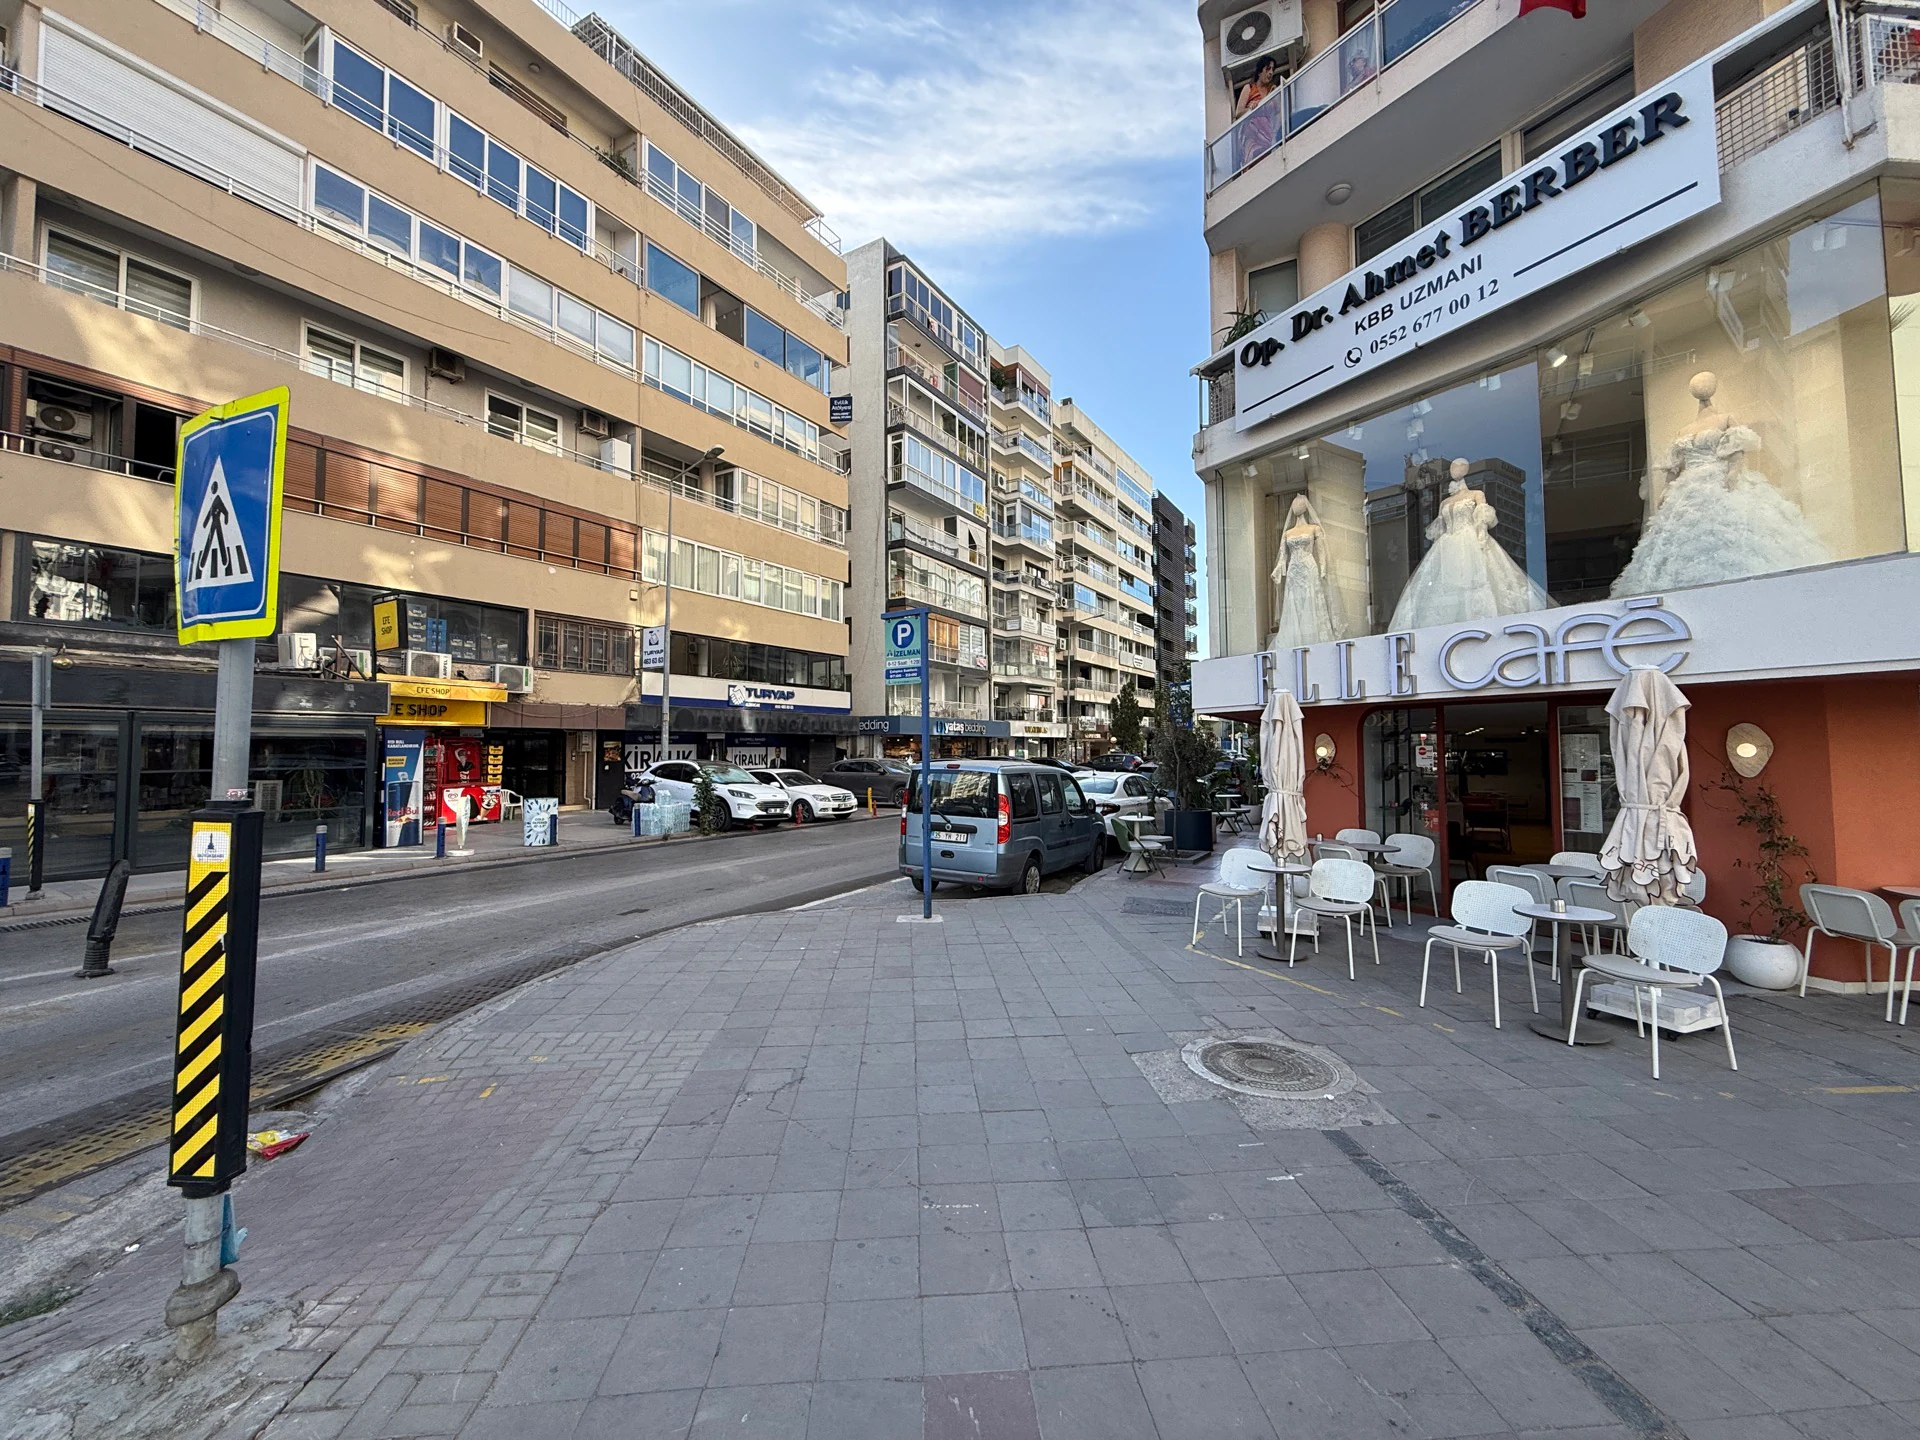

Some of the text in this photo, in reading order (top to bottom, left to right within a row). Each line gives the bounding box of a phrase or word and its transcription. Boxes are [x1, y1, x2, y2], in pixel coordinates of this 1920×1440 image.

[1240, 92, 1690, 368] Op. Dr. Ahmet BERBER
[1355, 254, 1482, 335] KBB UZMANI
[1370, 279, 1499, 354] 0552 677 00 12
[382, 616, 391, 625] EFE
[381, 626, 393, 635] SHOP
[898, 623, 912, 646] P
[1254, 632, 1416, 706] ELLE
[431, 687, 450, 695] SHOP
[745, 687, 795, 701] TURYAP
[391, 703, 448, 717] FE SHOP
[859, 719, 889, 731] edding
[945, 722, 986, 735] yataş bedding
[733, 751, 767, 766] KİRALIK
